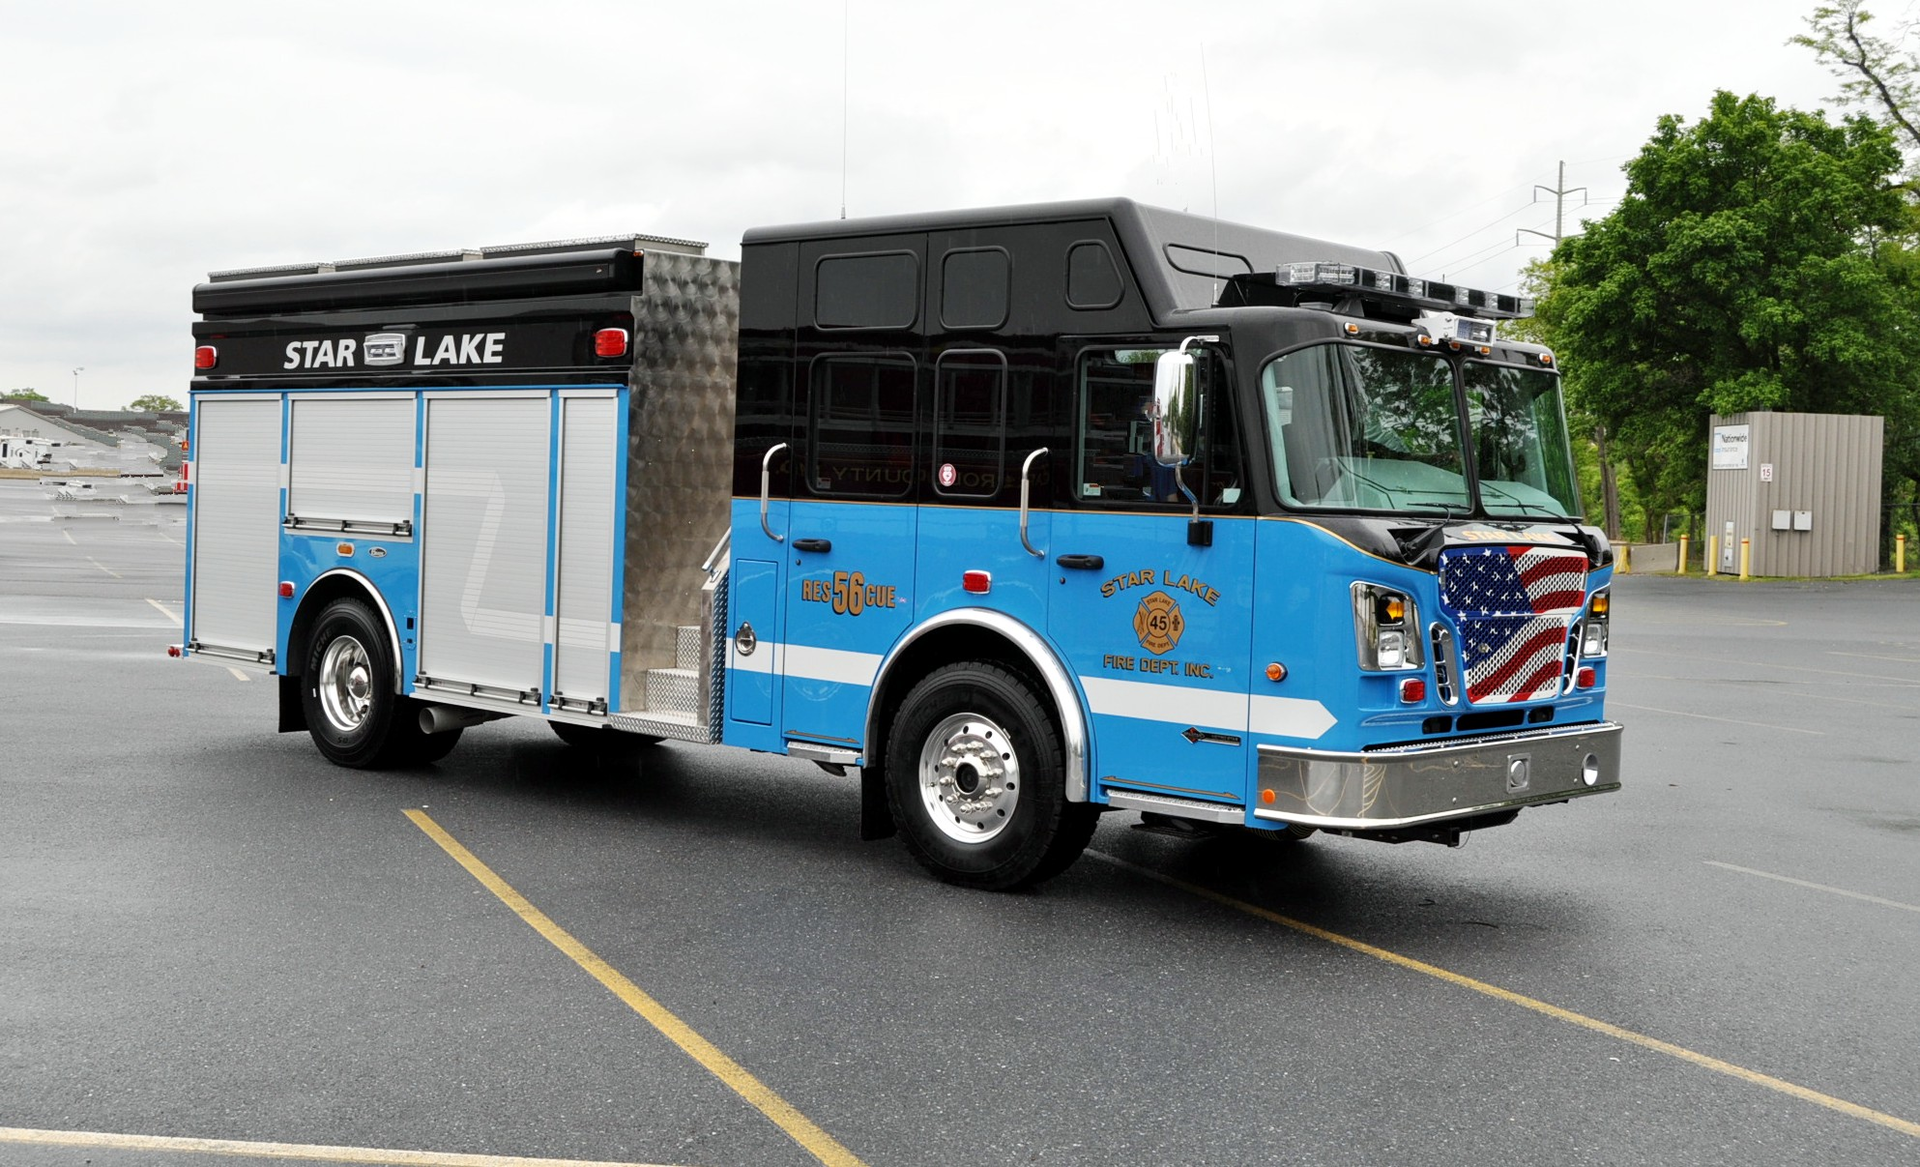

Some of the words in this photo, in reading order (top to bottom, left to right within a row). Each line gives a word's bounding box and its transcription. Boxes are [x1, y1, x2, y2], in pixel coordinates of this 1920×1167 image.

[283, 338, 356, 370] STAR
[413, 332, 506, 366] LAKE
[1721, 433, 1747, 443] Nationwide
[1762, 468, 1771, 477] 15
[1462, 530, 1511, 541] STAR
[802, 579, 831, 603] RES
[832, 571, 865, 616] 56
[865, 583, 896, 608] CUE
[1100, 569, 1155, 598] STAR
[1163, 570, 1221, 607] LAKE
[1158, 597, 1171, 606] LAKE
[1149, 615, 1167, 631] 45
[1103, 654, 1135, 671] FIRE
[1140, 658, 1179, 675] DEPT.
[1185, 662, 1214, 679] INC.
